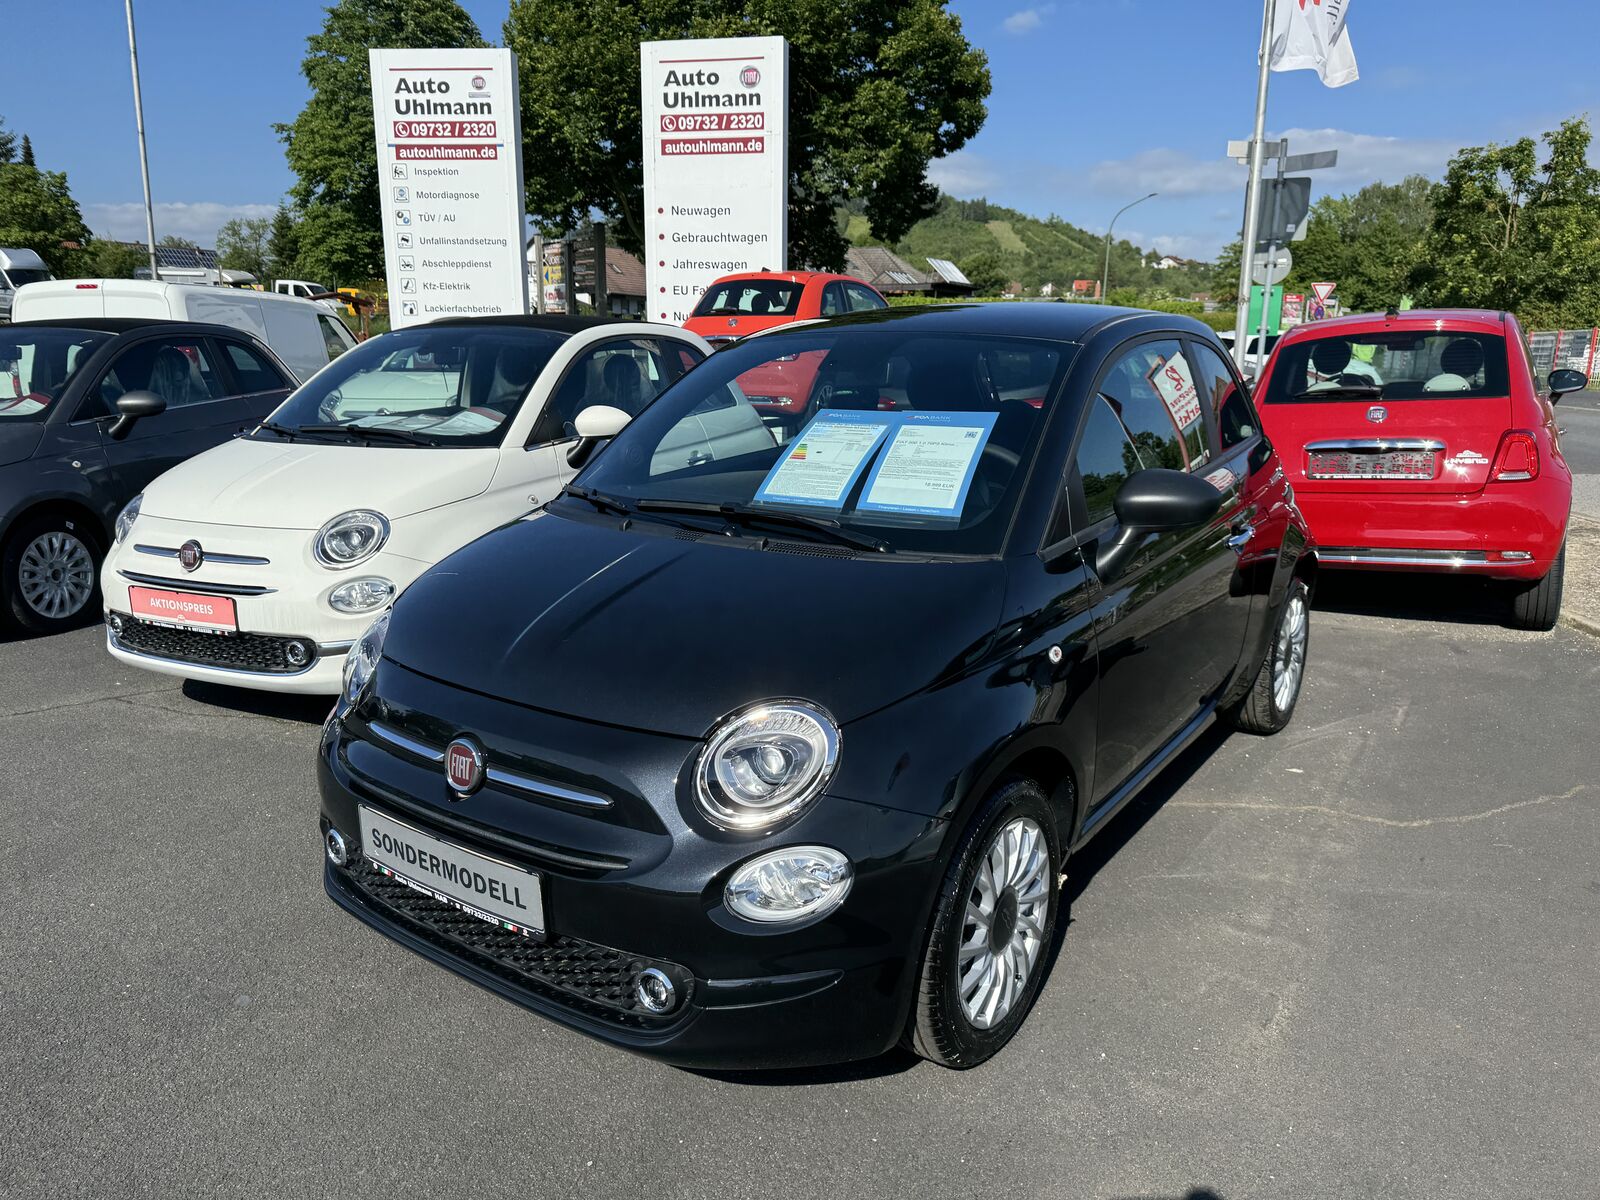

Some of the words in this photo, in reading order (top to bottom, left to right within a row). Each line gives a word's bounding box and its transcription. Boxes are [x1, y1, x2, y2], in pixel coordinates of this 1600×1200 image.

[664, 70, 719, 86] Auto
[744, 72, 756, 82] FIAT
[395, 78, 450, 93] Auto
[663, 92, 761, 108] Uhlmann
[395, 99, 492, 115] Uhlmann
[678, 116, 718, 130] 09732
[722, 115, 726, 128] /
[730, 114, 762, 128] 2320
[412, 123, 451, 136] 09732
[455, 123, 459, 136] /
[463, 123, 494, 136] 2320
[400, 146, 496, 158] autouhlmann.de
[665, 139, 762, 153] autouhlmann.de
[414, 168, 459, 176] Inspektion
[416, 191, 479, 200] Motordiagnose
[418, 212, 436, 222] TÜV
[444, 214, 456, 222] AU
[671, 206, 731, 218] Neuwagen
[420, 237, 507, 247] Unfallinstandsetzung
[672, 232, 768, 245] Gebrauchtwagen
[422, 260, 491, 269] Abschleppdienst
[673, 259, 748, 272] Jahreswagen
[423, 282, 471, 290] Kfz-Elektrik
[673, 286, 688, 295] EU
[424, 305, 501, 313] Lackierfachbetrieb
[150, 598, 213, 615] AKTIONSPREIS
[451, 753, 472, 780] FIAT
[372, 828, 526, 910] SONDERMODELL
[395, 874, 407, 885] Auto
[408, 881, 432, 896] Uhlmann
[462, 906, 500, 926] 09732/2320
